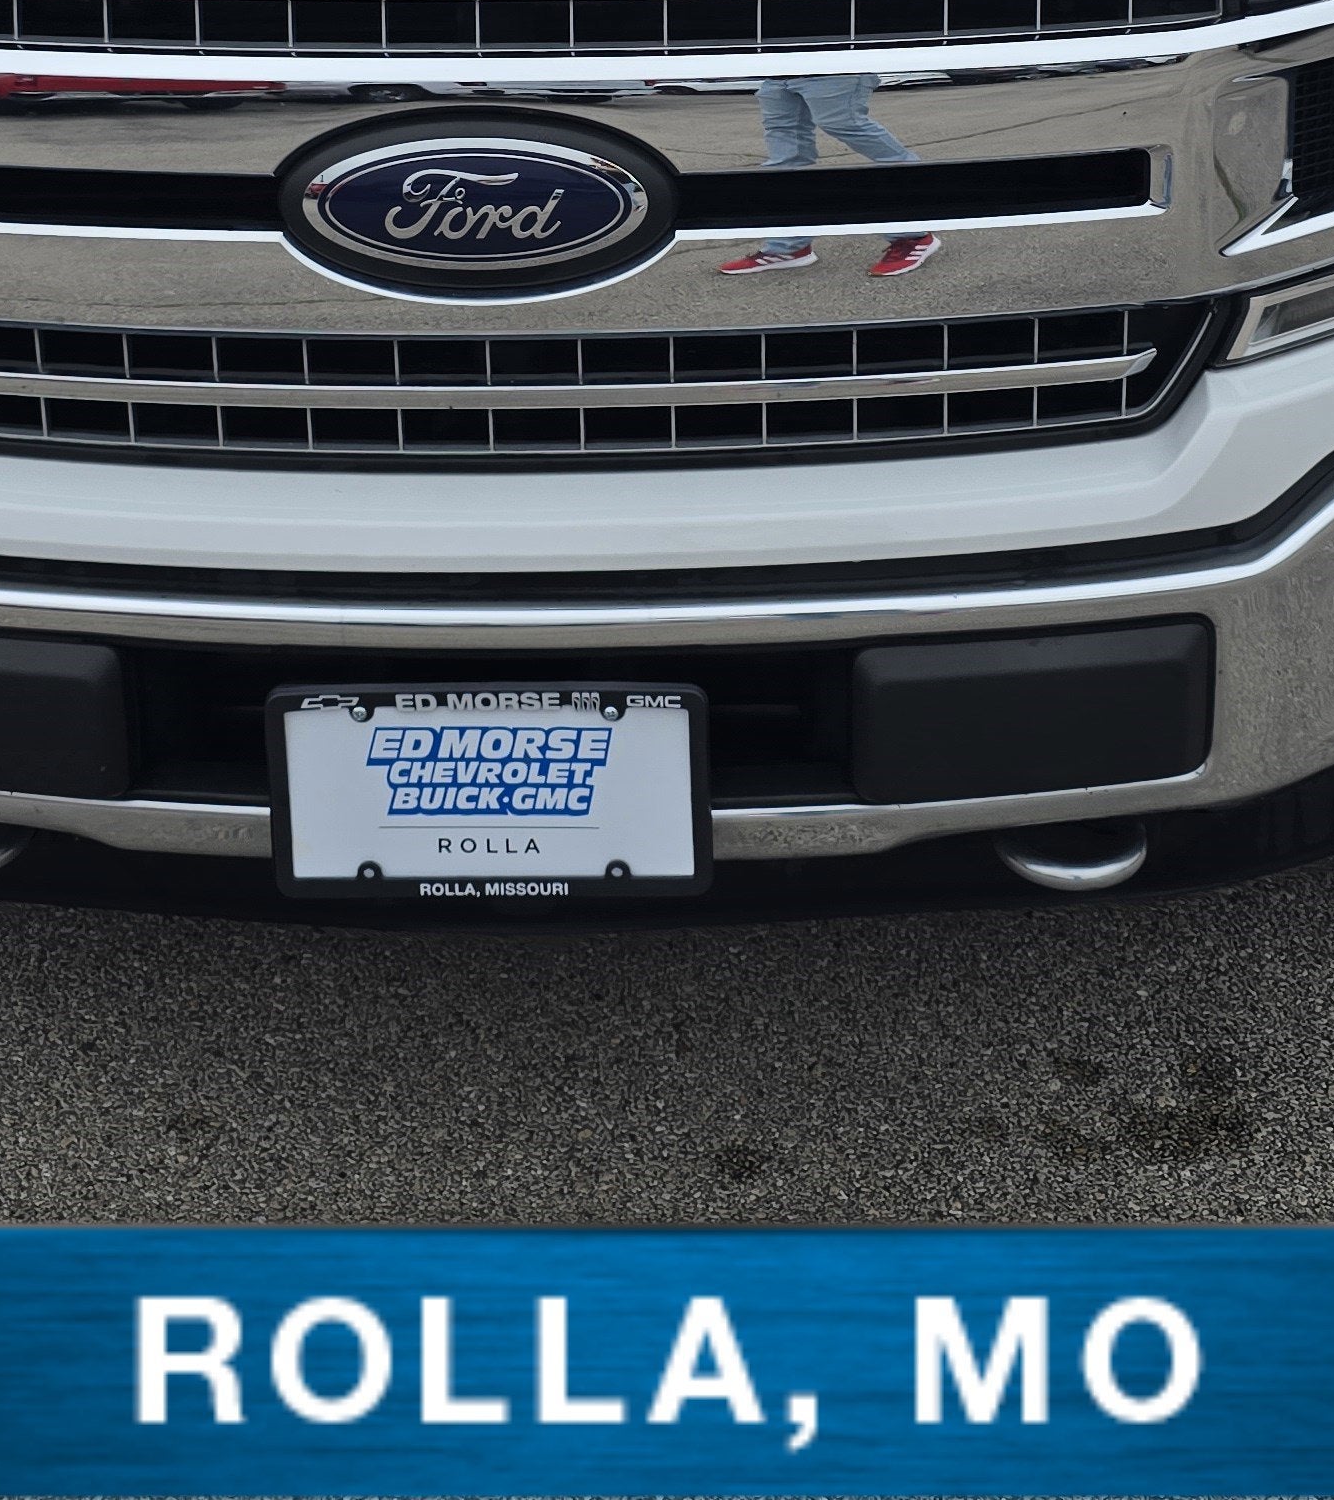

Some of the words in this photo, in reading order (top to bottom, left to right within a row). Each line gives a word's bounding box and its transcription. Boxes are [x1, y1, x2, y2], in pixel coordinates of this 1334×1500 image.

[384, 168, 565, 240] Ford
[395, 694, 438, 712] ED
[446, 691, 562, 712] MORSE
[626, 694, 682, 709] GMC
[370, 728, 434, 759] ED
[437, 728, 610, 759] MORSE
[438, 837, 541, 854] ROLLA
[419, 882, 481, 898] ROLLA,
[484, 881, 570, 896] MISSOURI
